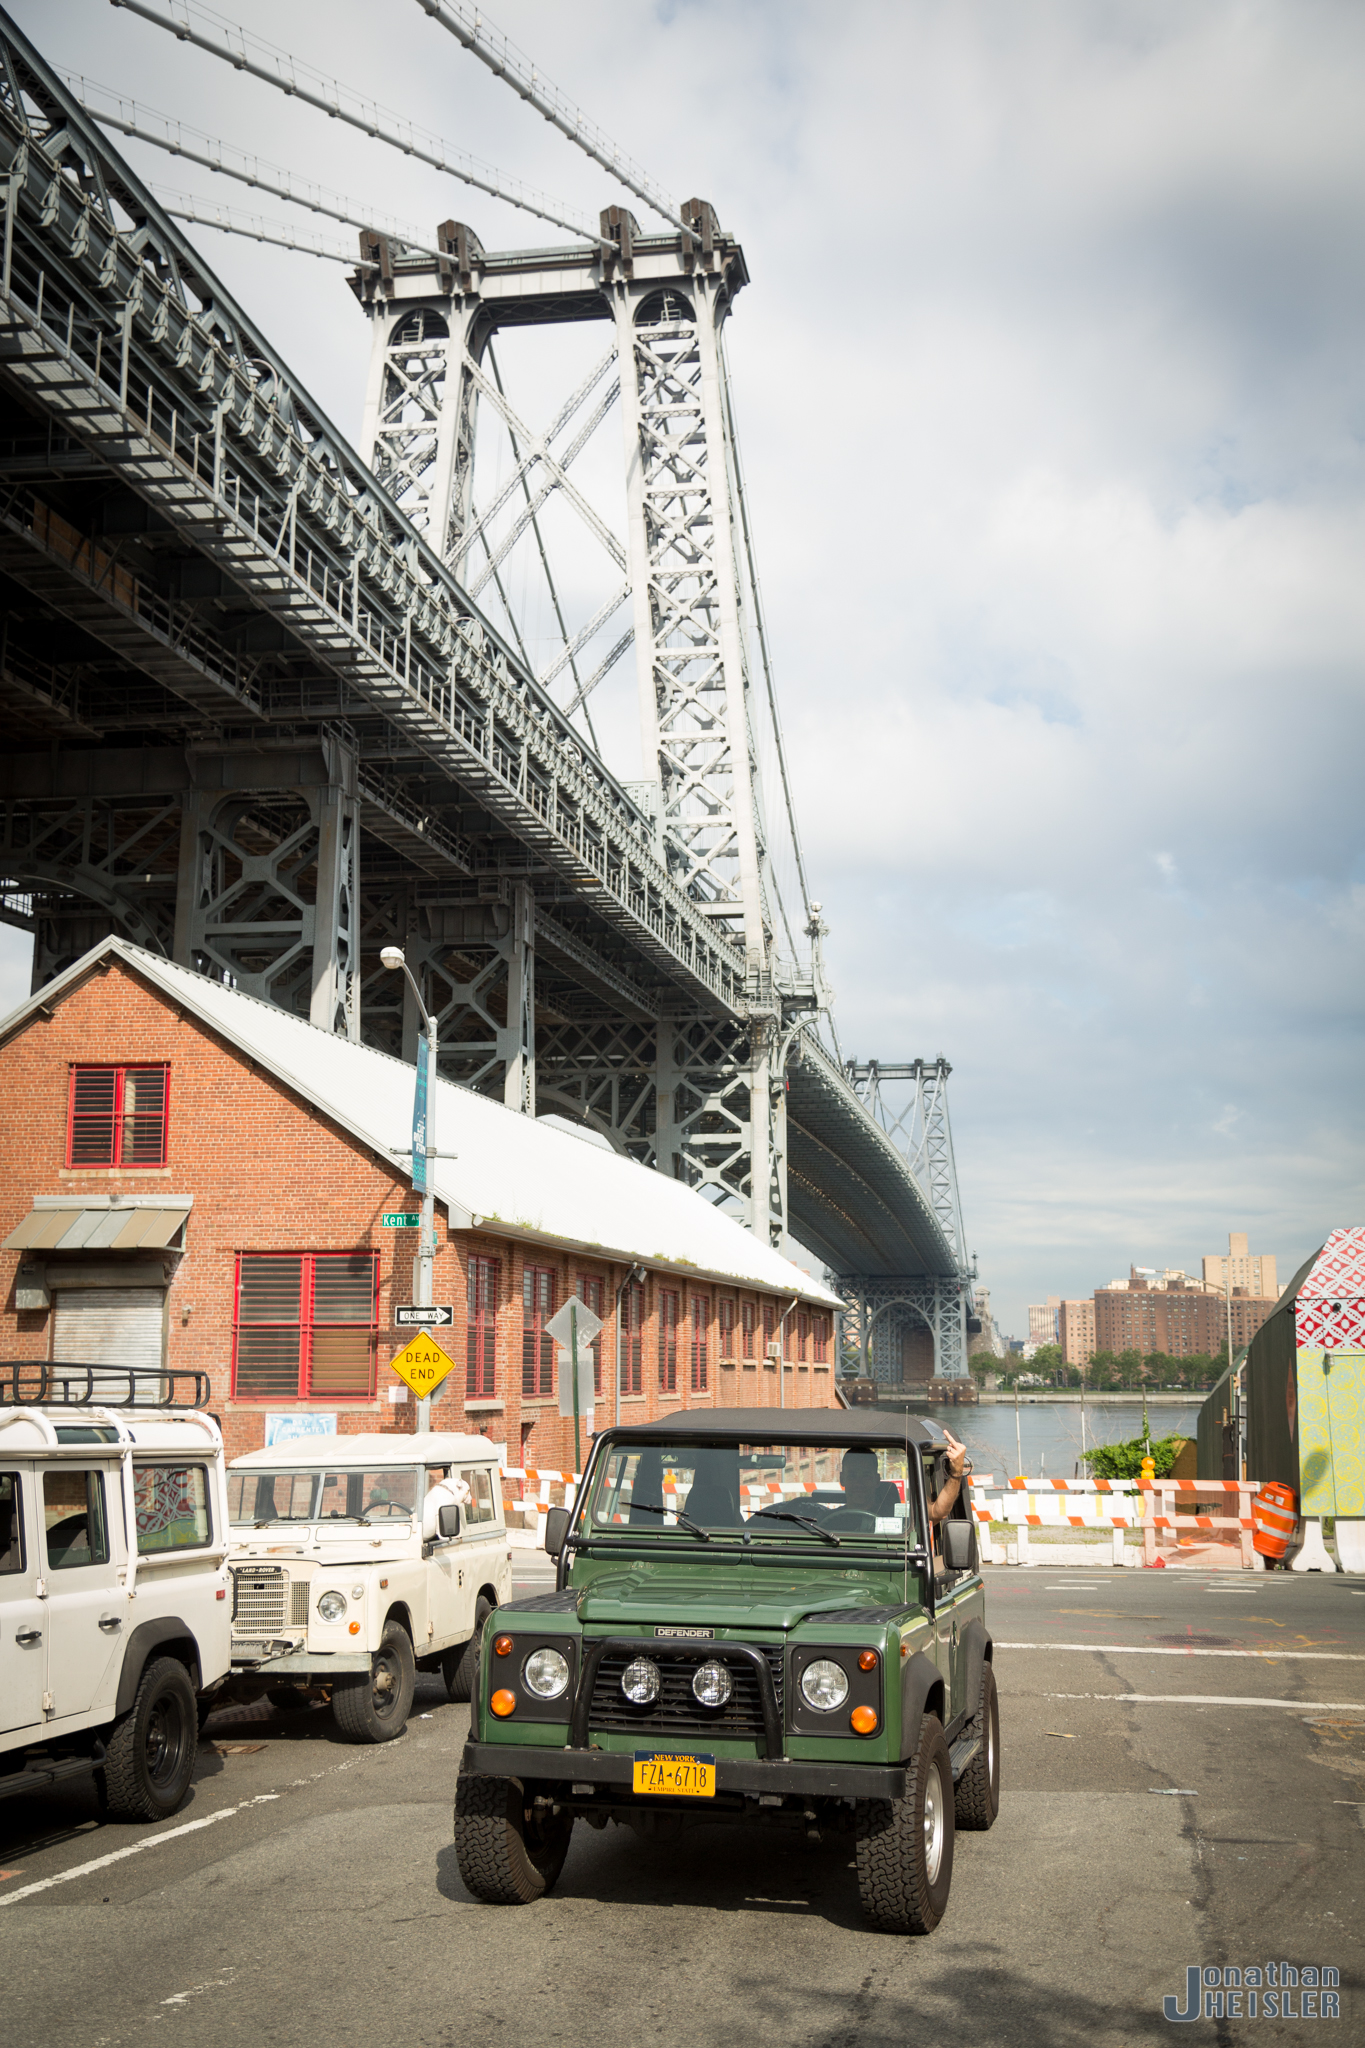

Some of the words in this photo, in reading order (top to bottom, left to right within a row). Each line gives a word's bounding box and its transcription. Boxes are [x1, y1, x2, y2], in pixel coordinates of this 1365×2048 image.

[383, 1215, 408, 1226] Kent
[404, 1312, 420, 1320] ONE
[427, 1312, 444, 1320] WAY
[405, 1352, 440, 1363] DEAD
[410, 1368, 435, 1379] END
[657, 1628, 711, 1638] DEFENDER
[654, 1754, 674, 1762] NEW
[674, 1755, 696, 1763] YORK
